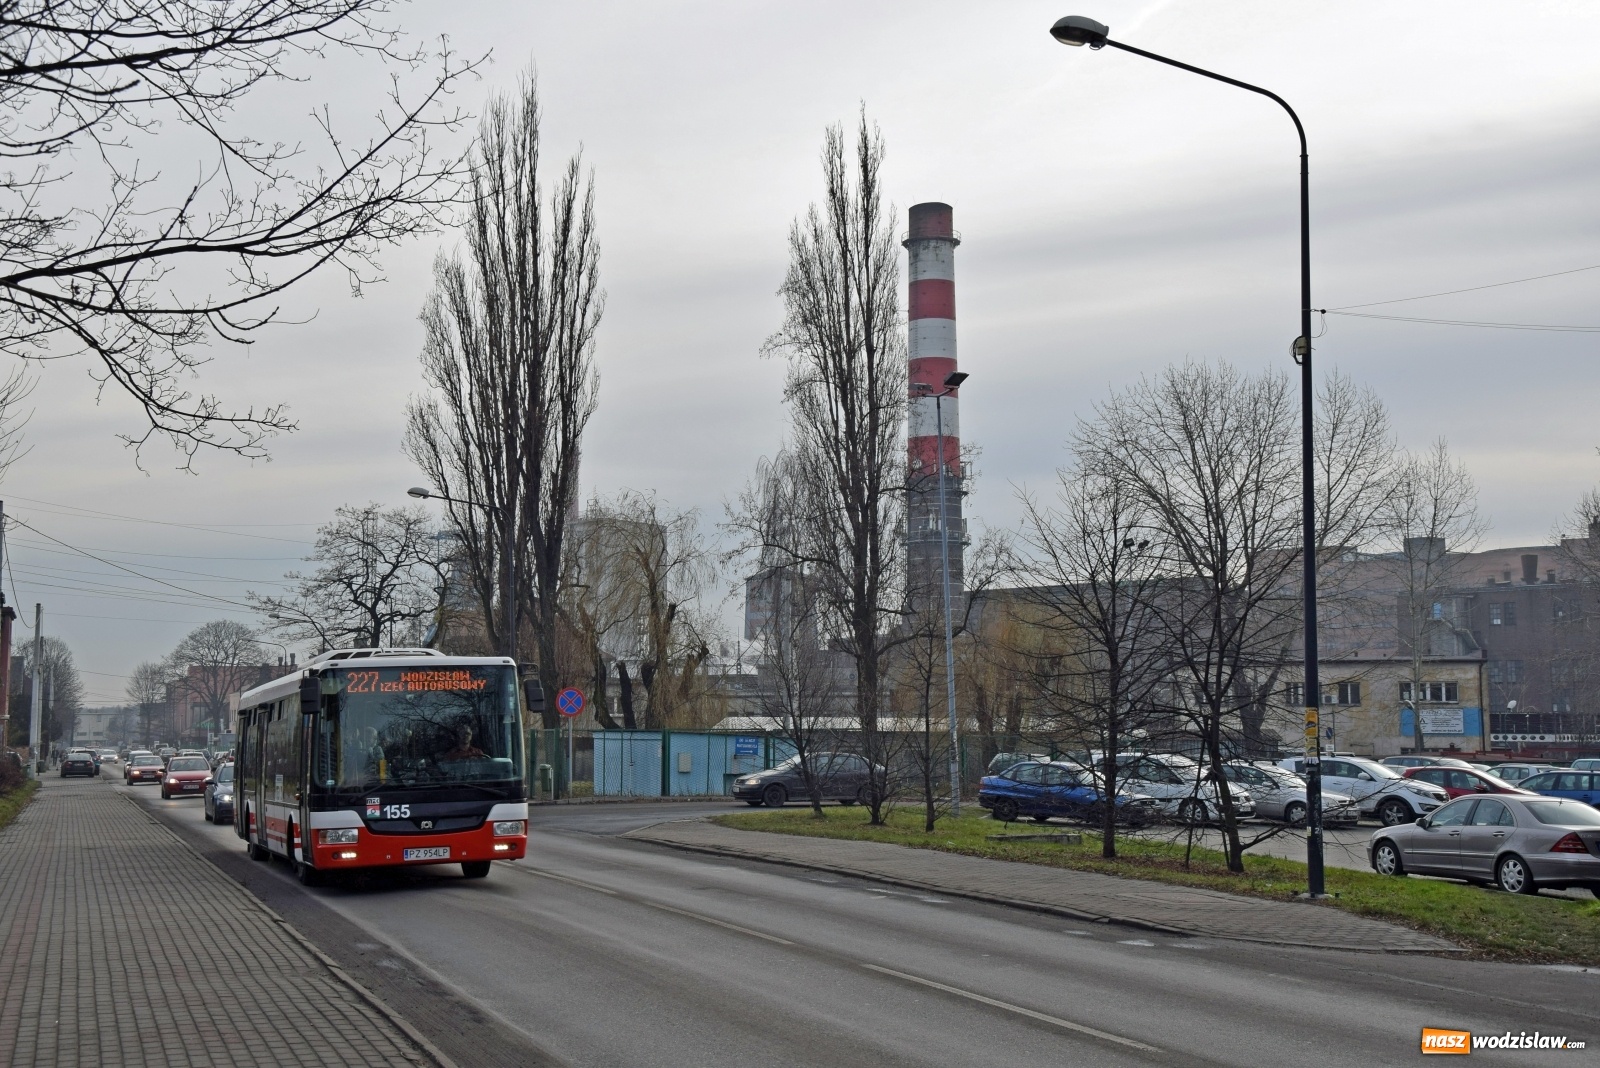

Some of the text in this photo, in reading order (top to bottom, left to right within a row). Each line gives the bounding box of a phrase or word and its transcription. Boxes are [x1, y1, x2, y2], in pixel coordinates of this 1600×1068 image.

[347, 671, 379, 693] 227
[400, 670, 470, 682] WODZISŁAW
[407, 679, 487, 692] AUTOBUSOWY
[383, 804, 410, 819] 155
[409, 848, 448, 858] PZ 954LP
